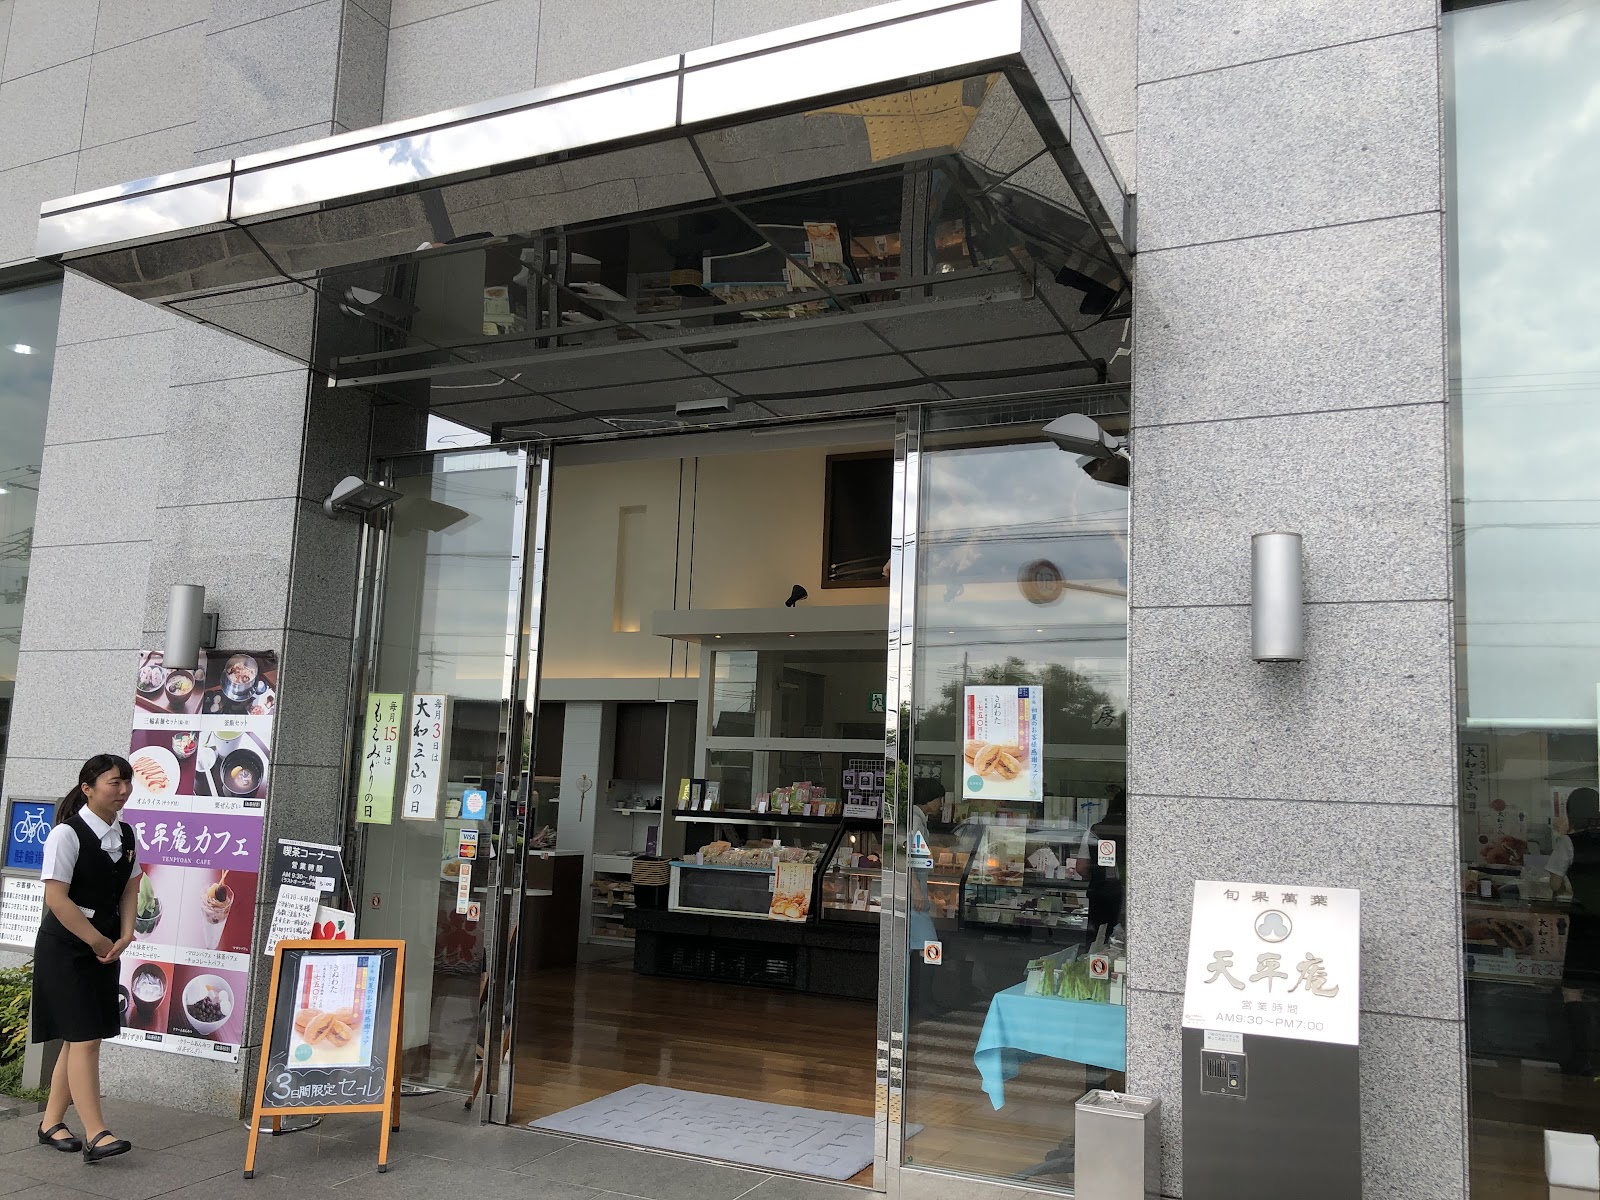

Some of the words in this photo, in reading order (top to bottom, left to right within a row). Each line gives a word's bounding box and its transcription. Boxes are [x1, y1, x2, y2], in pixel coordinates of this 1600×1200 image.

[383, 701, 398, 765] 毎月15日は
[431, 699, 443, 762] 毎月3日は
[410, 697, 431, 813] 大和三山の日
[463, 833, 476, 841] VISA
[196, 858, 212, 866] CAFE
[282, 845, 335, 861] 喫茶コーナー
[291, 861, 324, 874] 営業時間
[1223, 888, 1328, 907] 旬果萬葉
[1538, 918, 1550, 956] 大和三山
[1203, 949, 1340, 998] 天平庵
[1241, 1000, 1298, 1015] 営業時間
